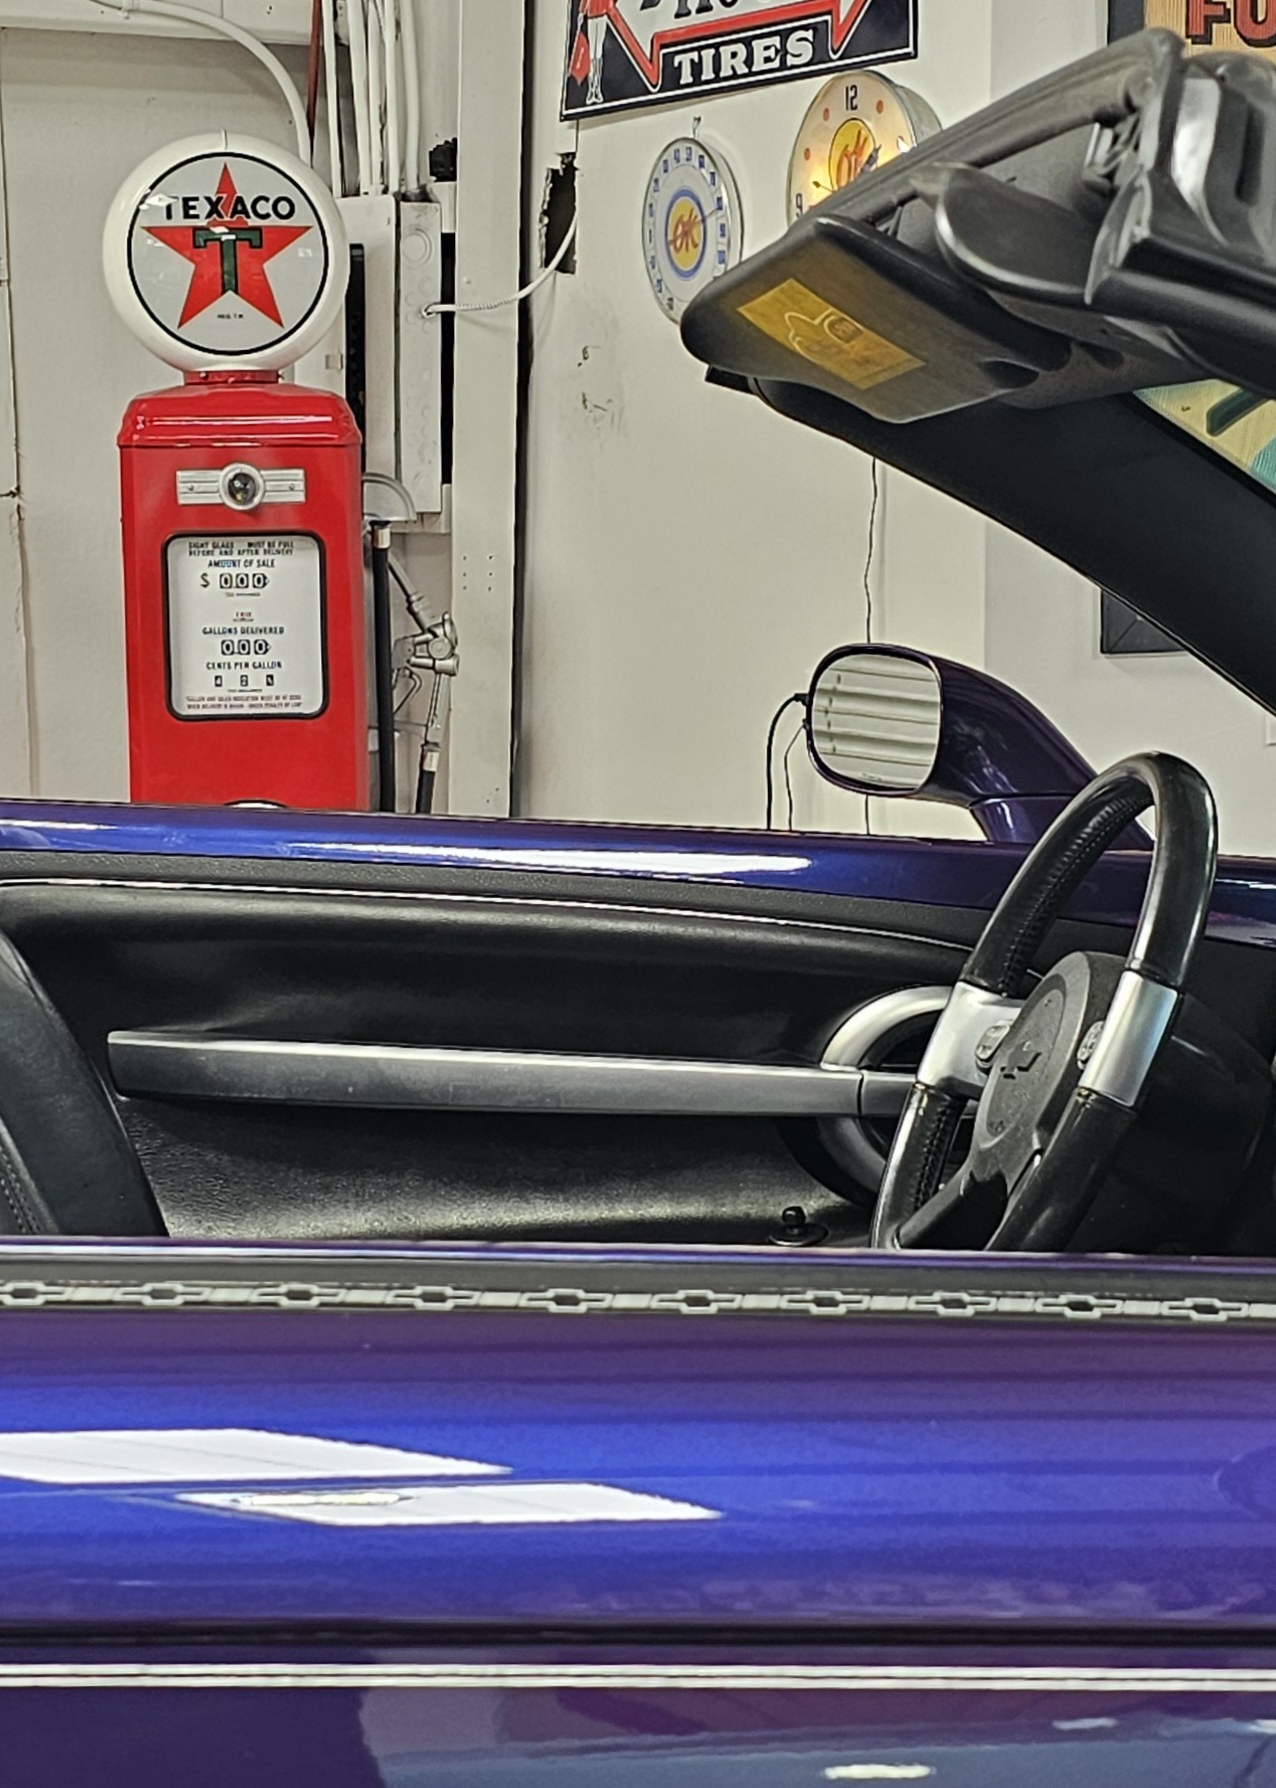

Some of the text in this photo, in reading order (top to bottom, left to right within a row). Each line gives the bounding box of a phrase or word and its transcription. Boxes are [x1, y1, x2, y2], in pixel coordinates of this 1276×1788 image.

[674, 28, 816, 85] TIRES
[845, 84, 859, 111] 12
[161, 195, 296, 220] TEXACO
[207, 559, 242, 568] AMOUNT
[256, 559, 275, 568] SALE
[202, 626, 285, 635] GALLONS DELIVERED
[206, 661, 282, 670] CENTS PER GALLON
